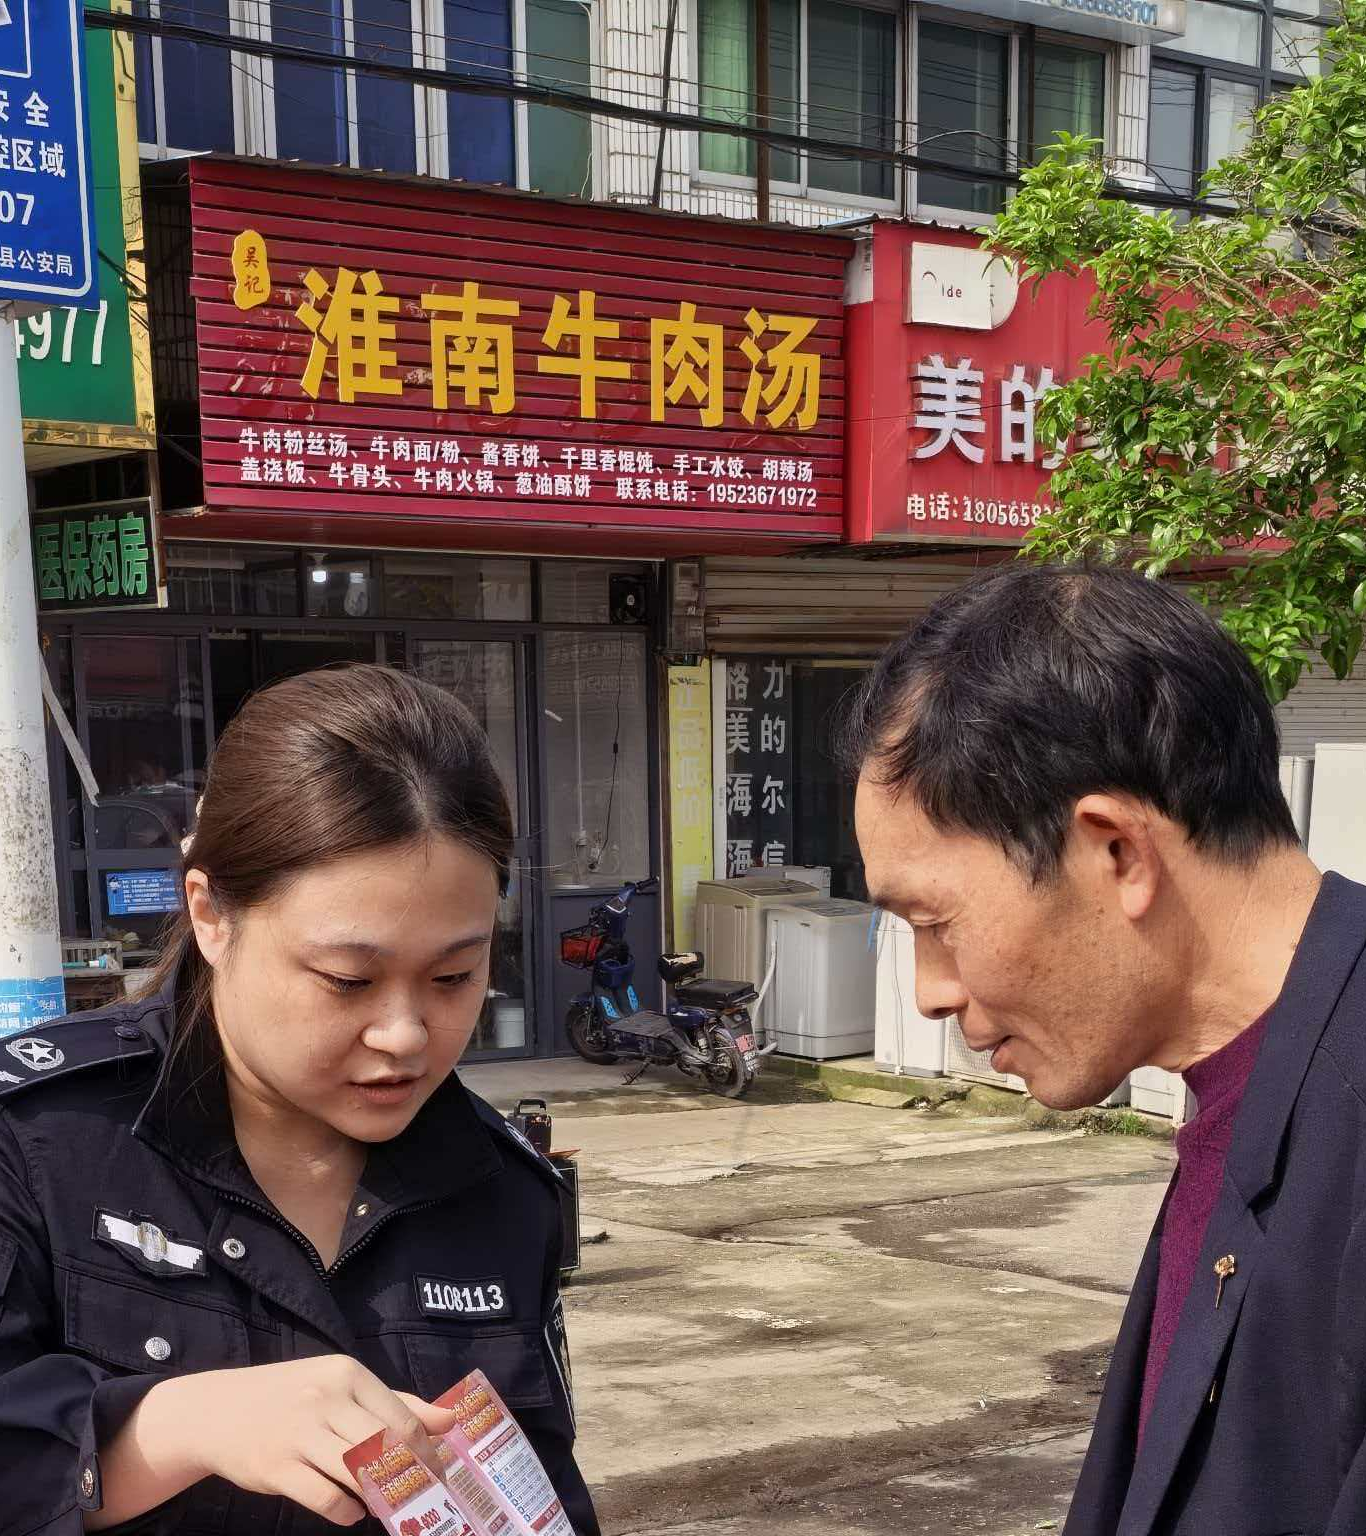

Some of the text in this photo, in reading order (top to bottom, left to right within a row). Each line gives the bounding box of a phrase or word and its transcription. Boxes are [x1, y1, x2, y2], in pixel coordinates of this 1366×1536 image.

[293, 265, 822, 431] 淮南牛肉汤
[35, 511, 149, 601] 医保药房
